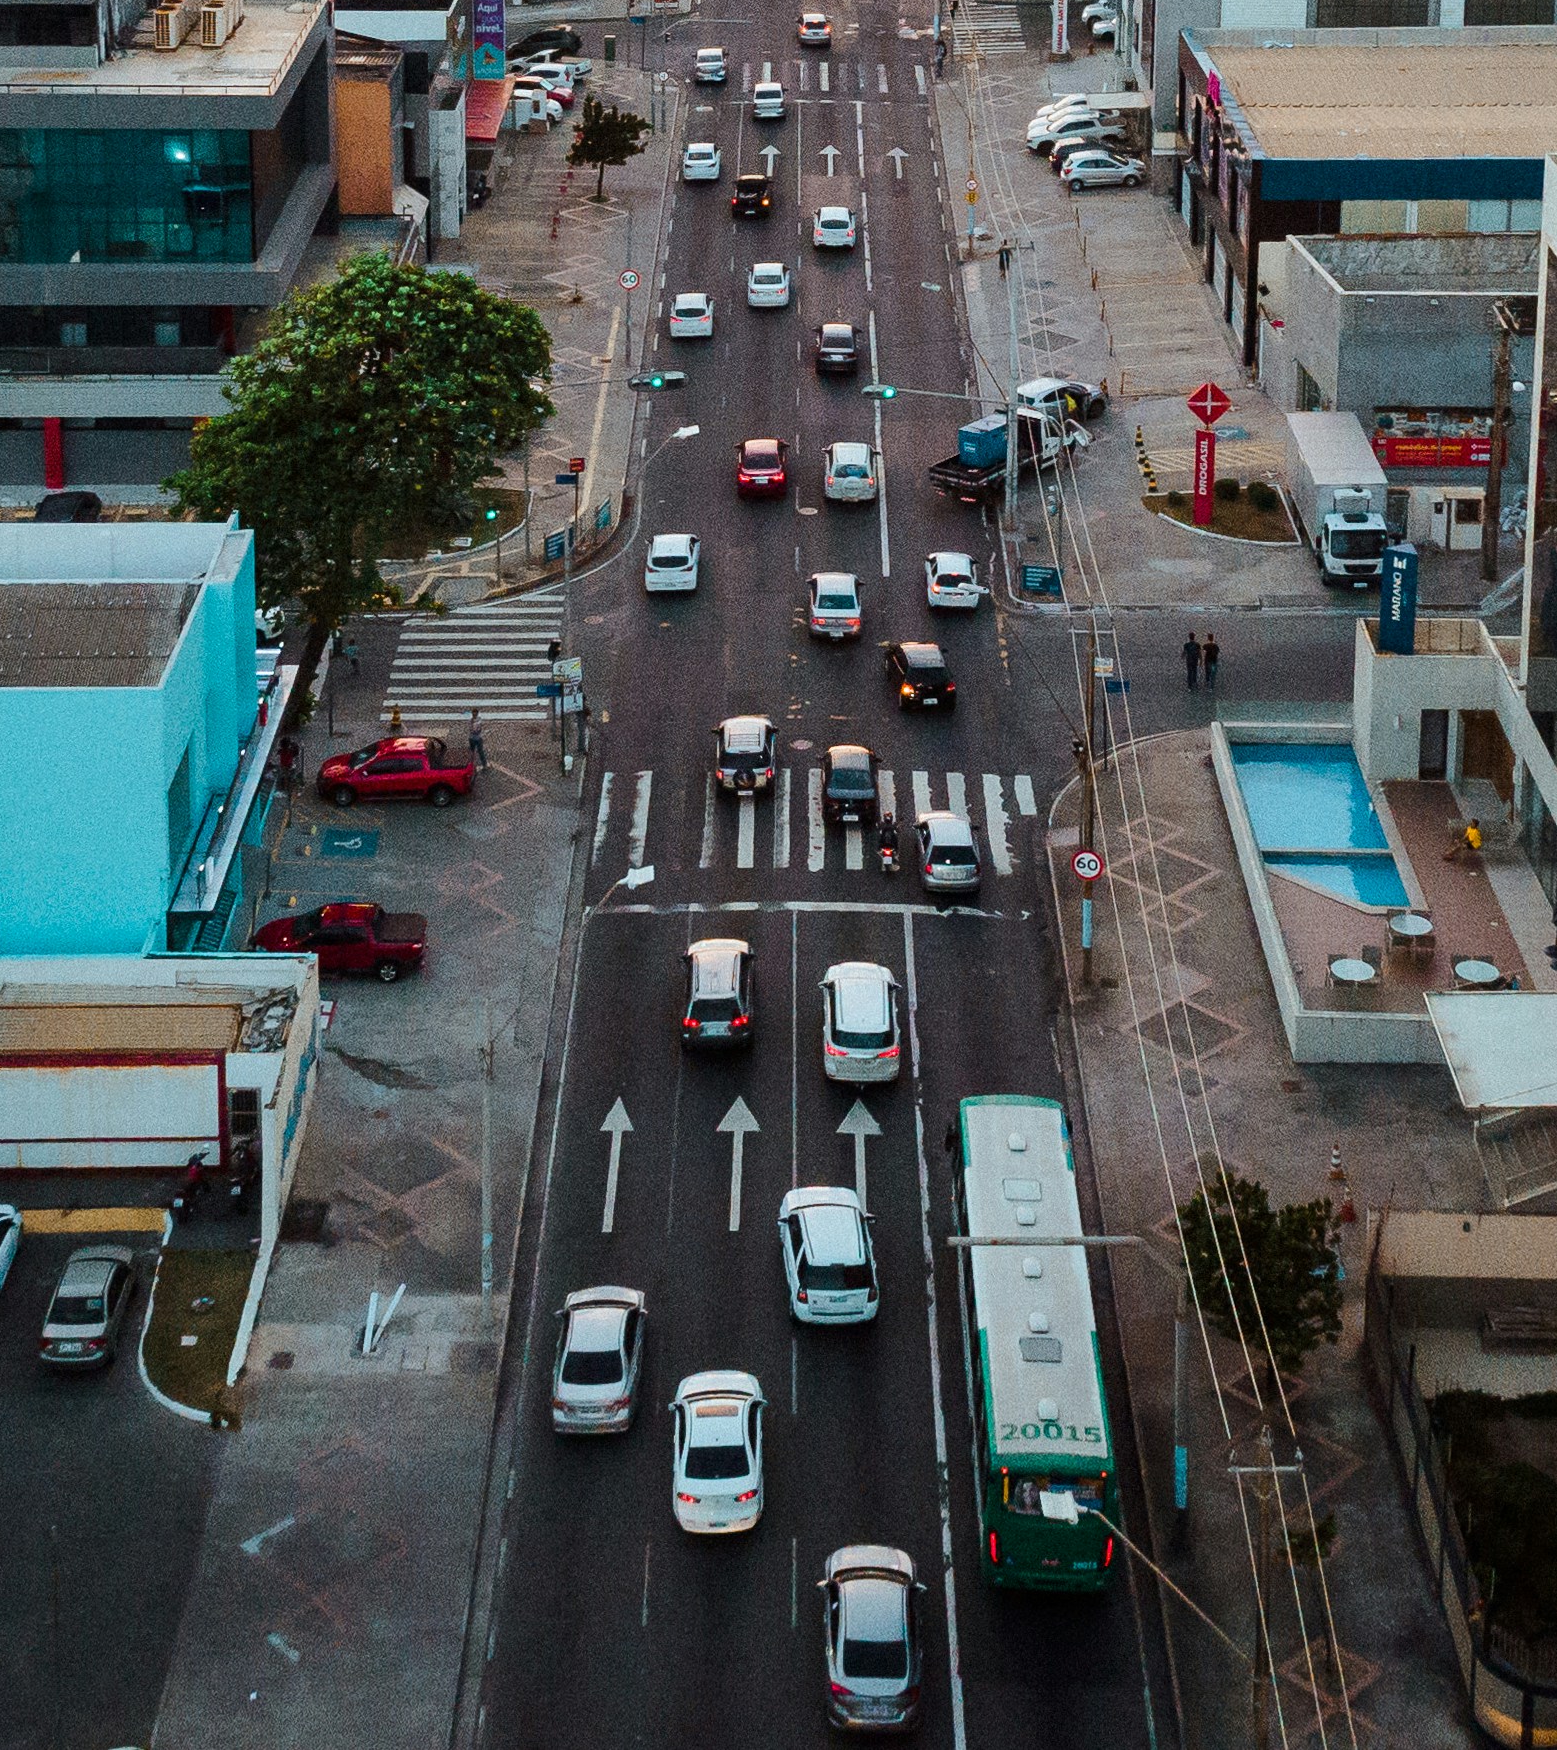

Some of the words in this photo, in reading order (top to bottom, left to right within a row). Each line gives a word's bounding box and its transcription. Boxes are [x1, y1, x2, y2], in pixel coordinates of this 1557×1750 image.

[622, 275, 637, 284] 60
[1198, 438, 1209, 496] DROGASIL
[1391, 571, 1402, 622] MARANO
[1076, 857, 1098, 871] 60
[1001, 1423, 1101, 1443] 20015
